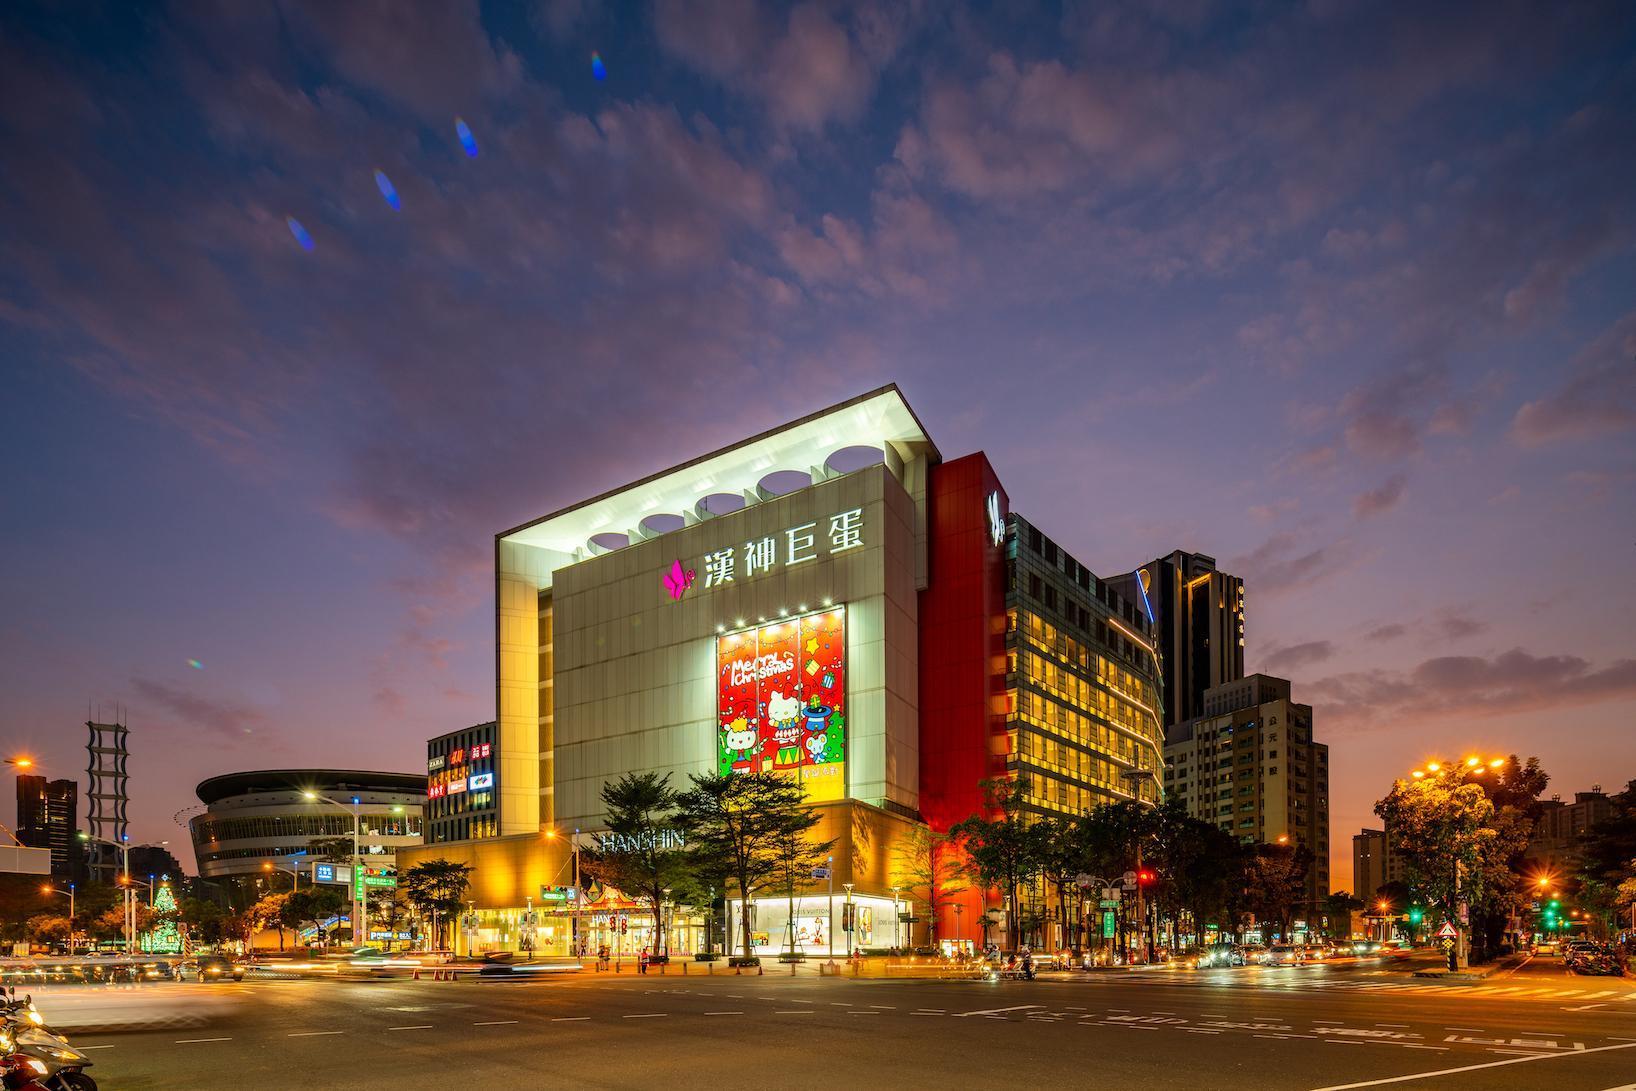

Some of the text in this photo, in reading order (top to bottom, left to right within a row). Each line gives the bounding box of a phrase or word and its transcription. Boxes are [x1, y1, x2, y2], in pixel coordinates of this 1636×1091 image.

[704, 508, 865, 588] 漢神巨蛋
[731, 652, 778, 687] Merry
[734, 657, 795, 686] Christmas
